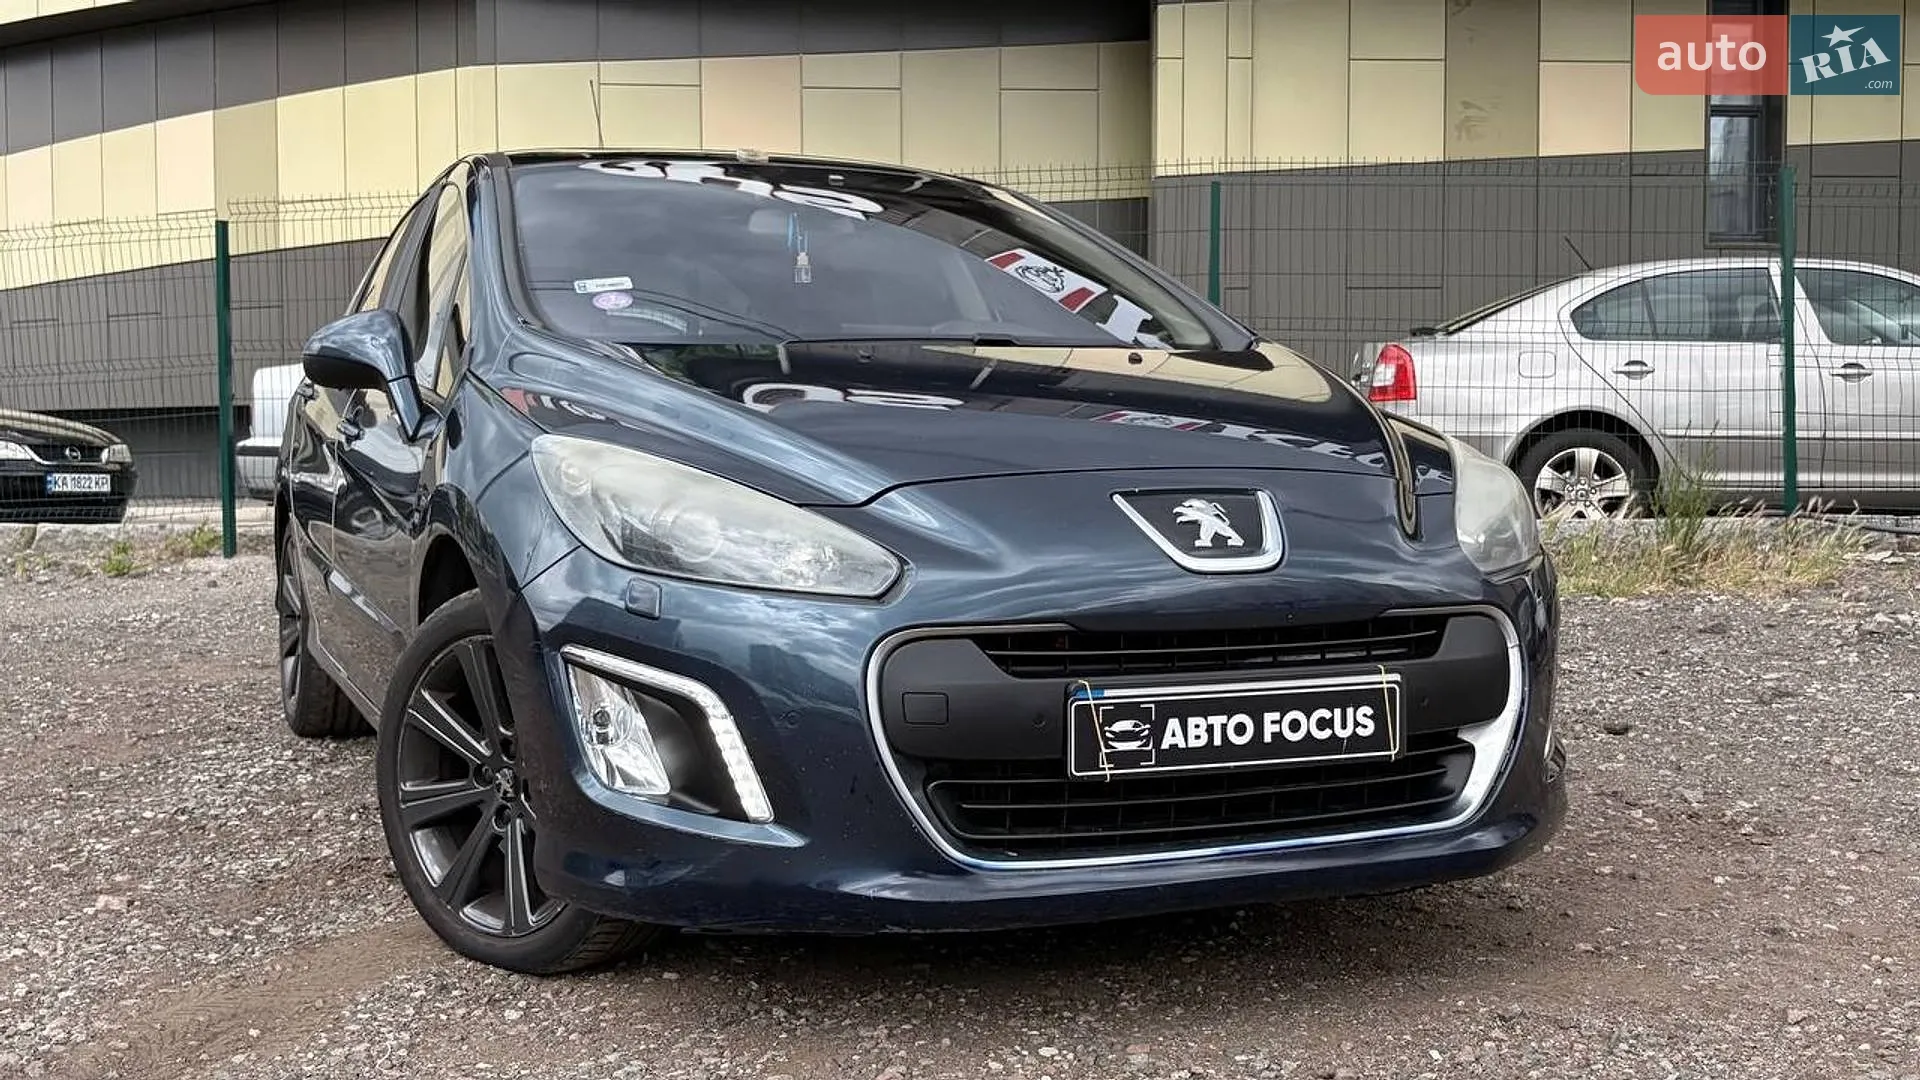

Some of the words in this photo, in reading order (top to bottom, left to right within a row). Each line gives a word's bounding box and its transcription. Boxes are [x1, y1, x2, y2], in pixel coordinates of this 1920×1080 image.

[54, 475, 69, 489] KA
[1160, 712, 1255, 750] АВТО
[1263, 705, 1376, 743] FOCUS
